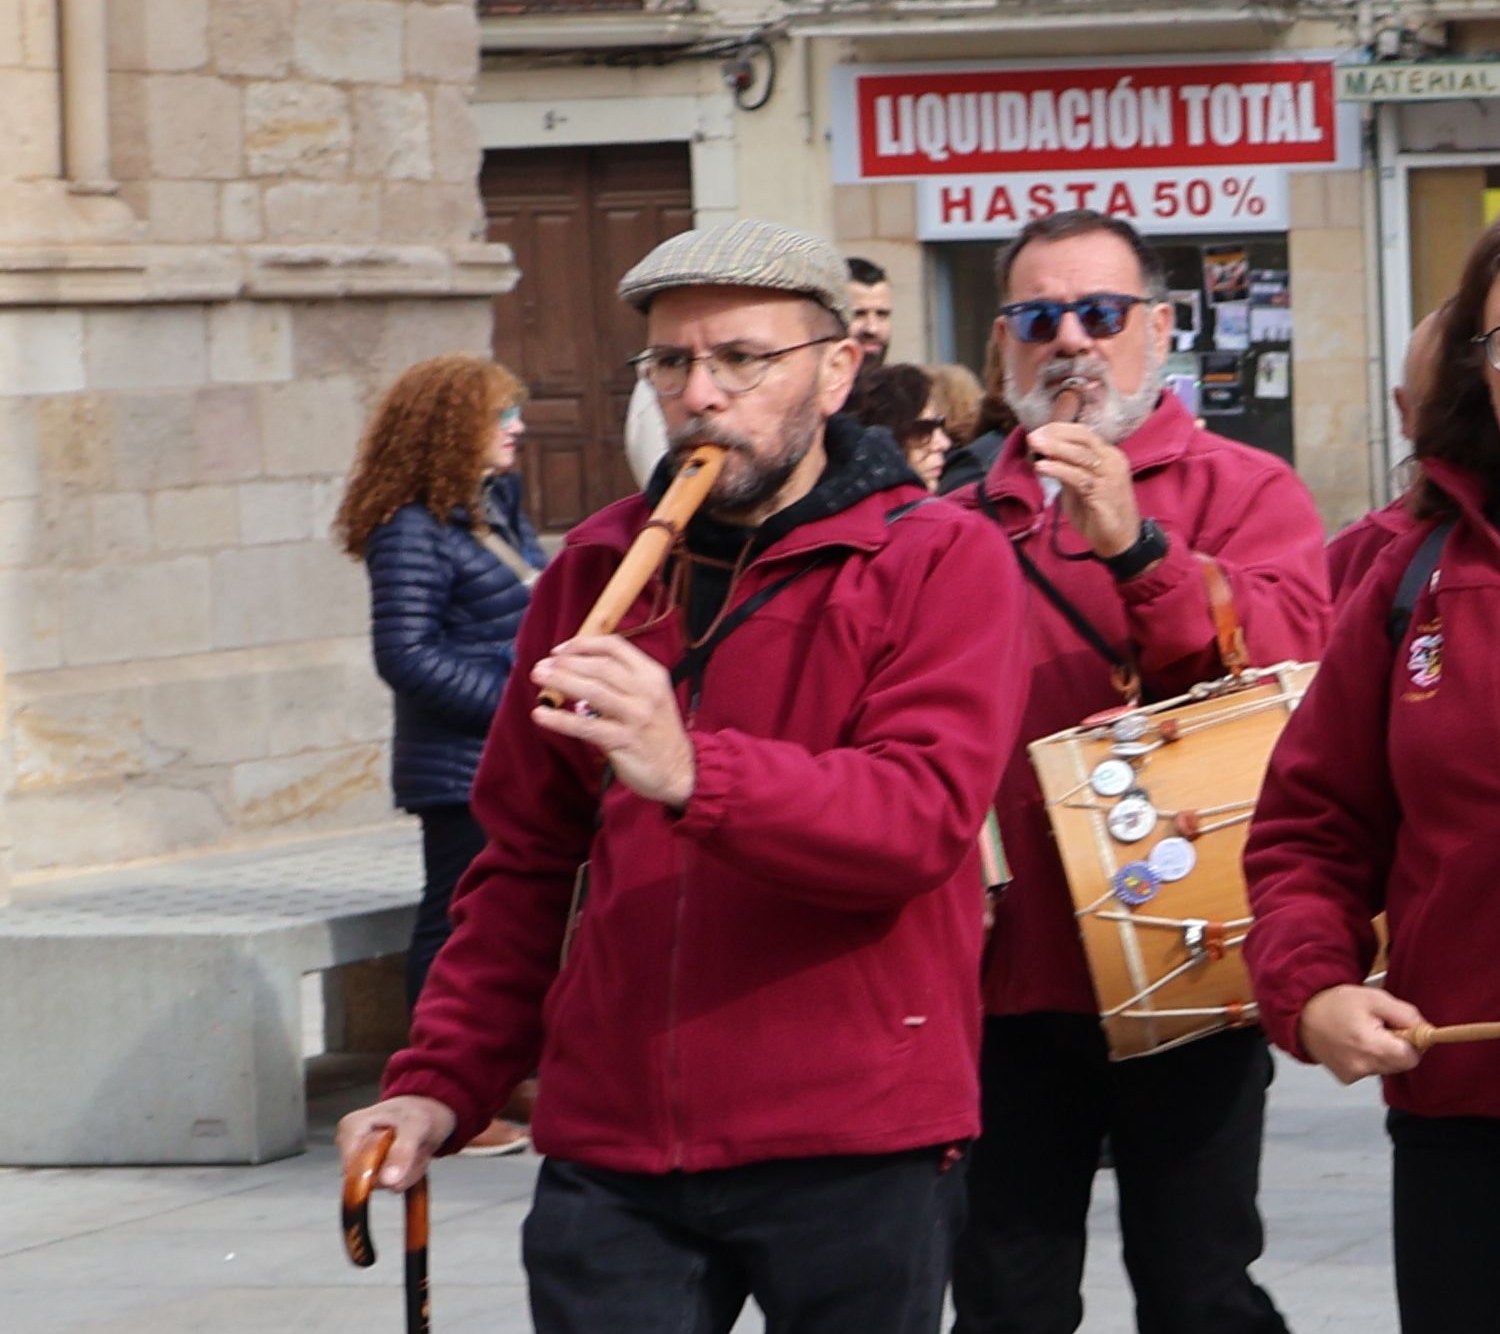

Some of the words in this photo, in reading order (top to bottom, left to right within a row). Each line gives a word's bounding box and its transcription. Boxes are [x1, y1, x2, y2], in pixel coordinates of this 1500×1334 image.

[1345, 69, 1497, 98] MATERIAL
[875, 78, 1173, 162] LIQUIDACIÓN
[1180, 81, 1323, 146] TOTAL
[941, 180, 1137, 223] HASTA
